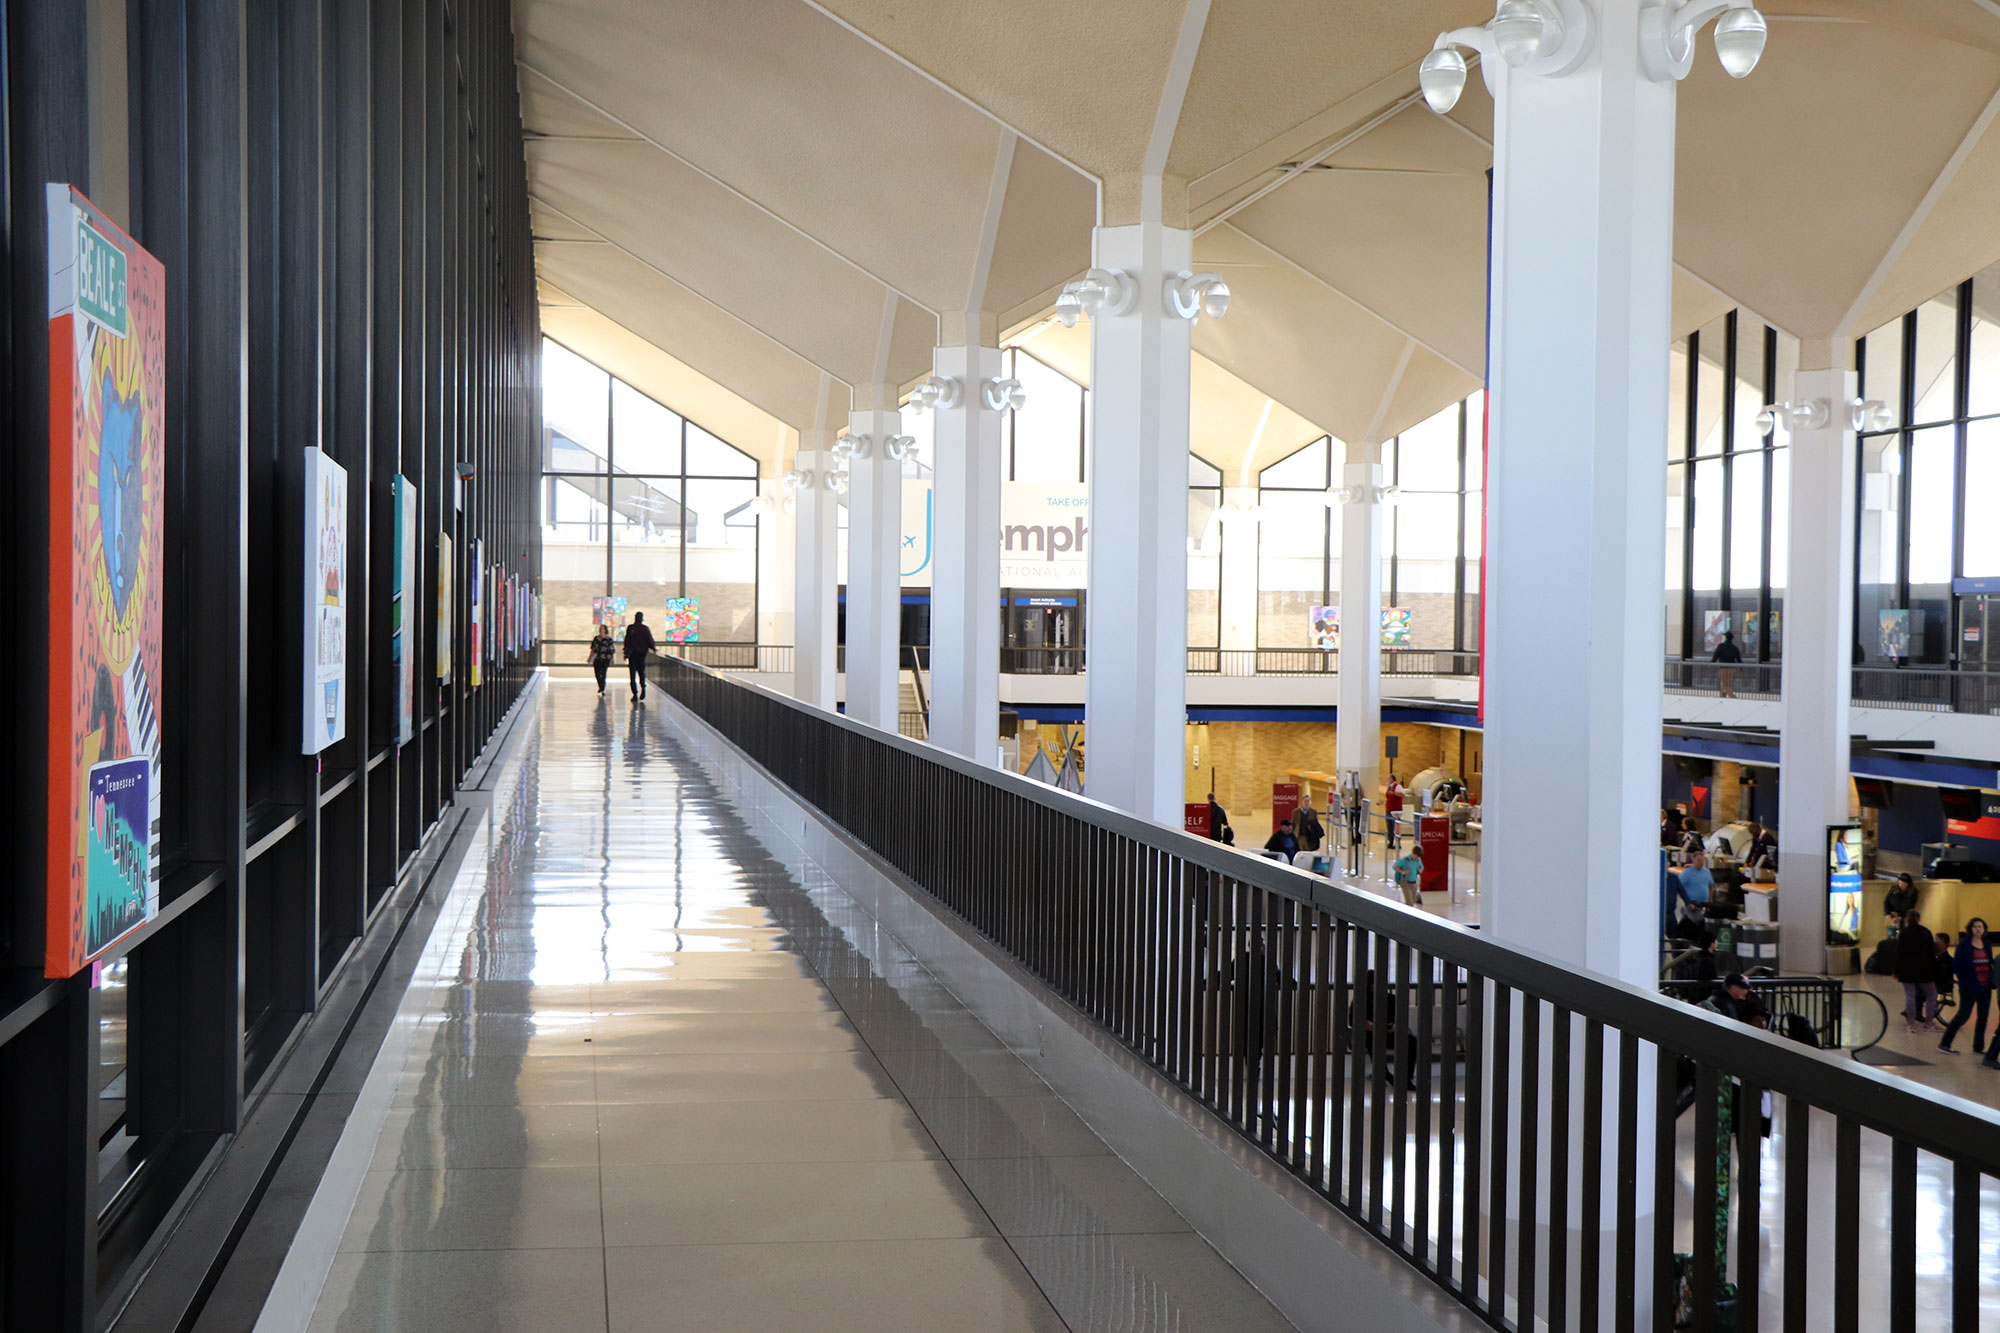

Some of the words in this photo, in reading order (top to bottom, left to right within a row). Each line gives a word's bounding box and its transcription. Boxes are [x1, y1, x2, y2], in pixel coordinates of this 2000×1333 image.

[79, 228, 116, 317] BEALE
[118, 279, 126, 308] ST
[1047, 498, 1071, 506] TAKE
[1000, 517, 1088, 562] mph
[1068, 567, 1088, 577] AI
[105, 774, 135, 793] Tennessee
[90, 790, 94, 831] I
[105, 806, 147, 909] MEMPHIS
